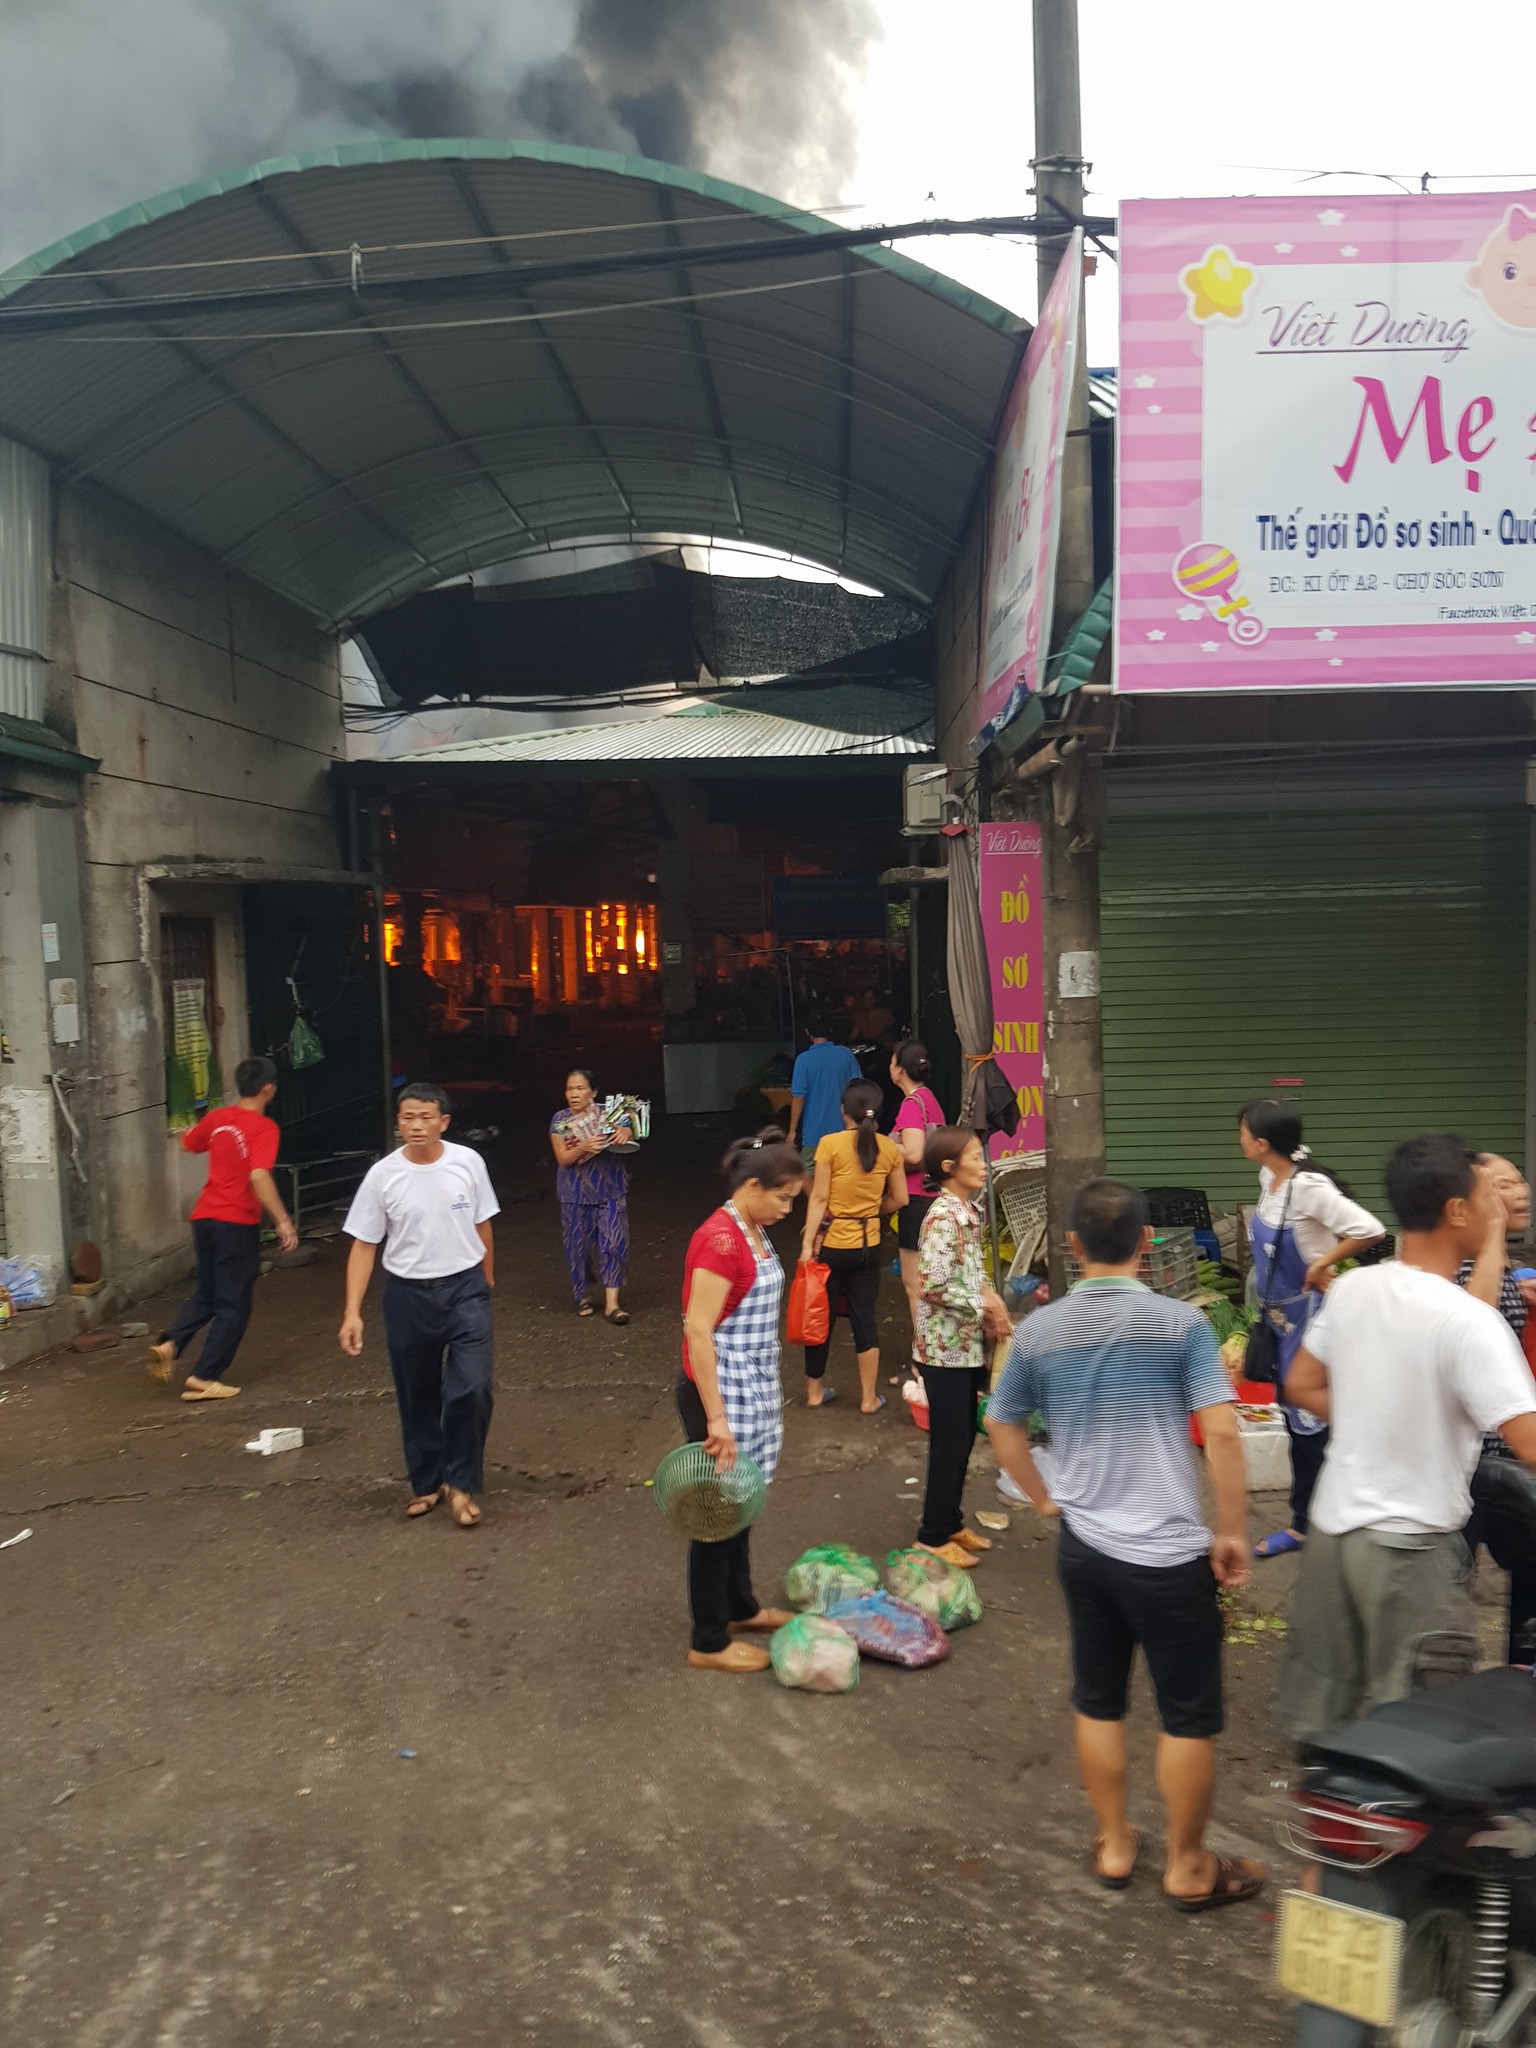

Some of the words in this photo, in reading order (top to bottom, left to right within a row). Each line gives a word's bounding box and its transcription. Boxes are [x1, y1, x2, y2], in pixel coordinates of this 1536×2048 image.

[1333, 375, 1496, 493] Mẹ
[1256, 507, 1303, 550] Thế
[1306, 512, 1347, 559] giới
[1355, 506, 1389, 549] Đồ
[1395, 519, 1421, 548] sơ
[1428, 510, 1475, 548] sinh
[1000, 873, 1029, 923] ĐỒ
[1002, 951, 1028, 989] SƠ
[993, 1021, 1040, 1053] SINH
